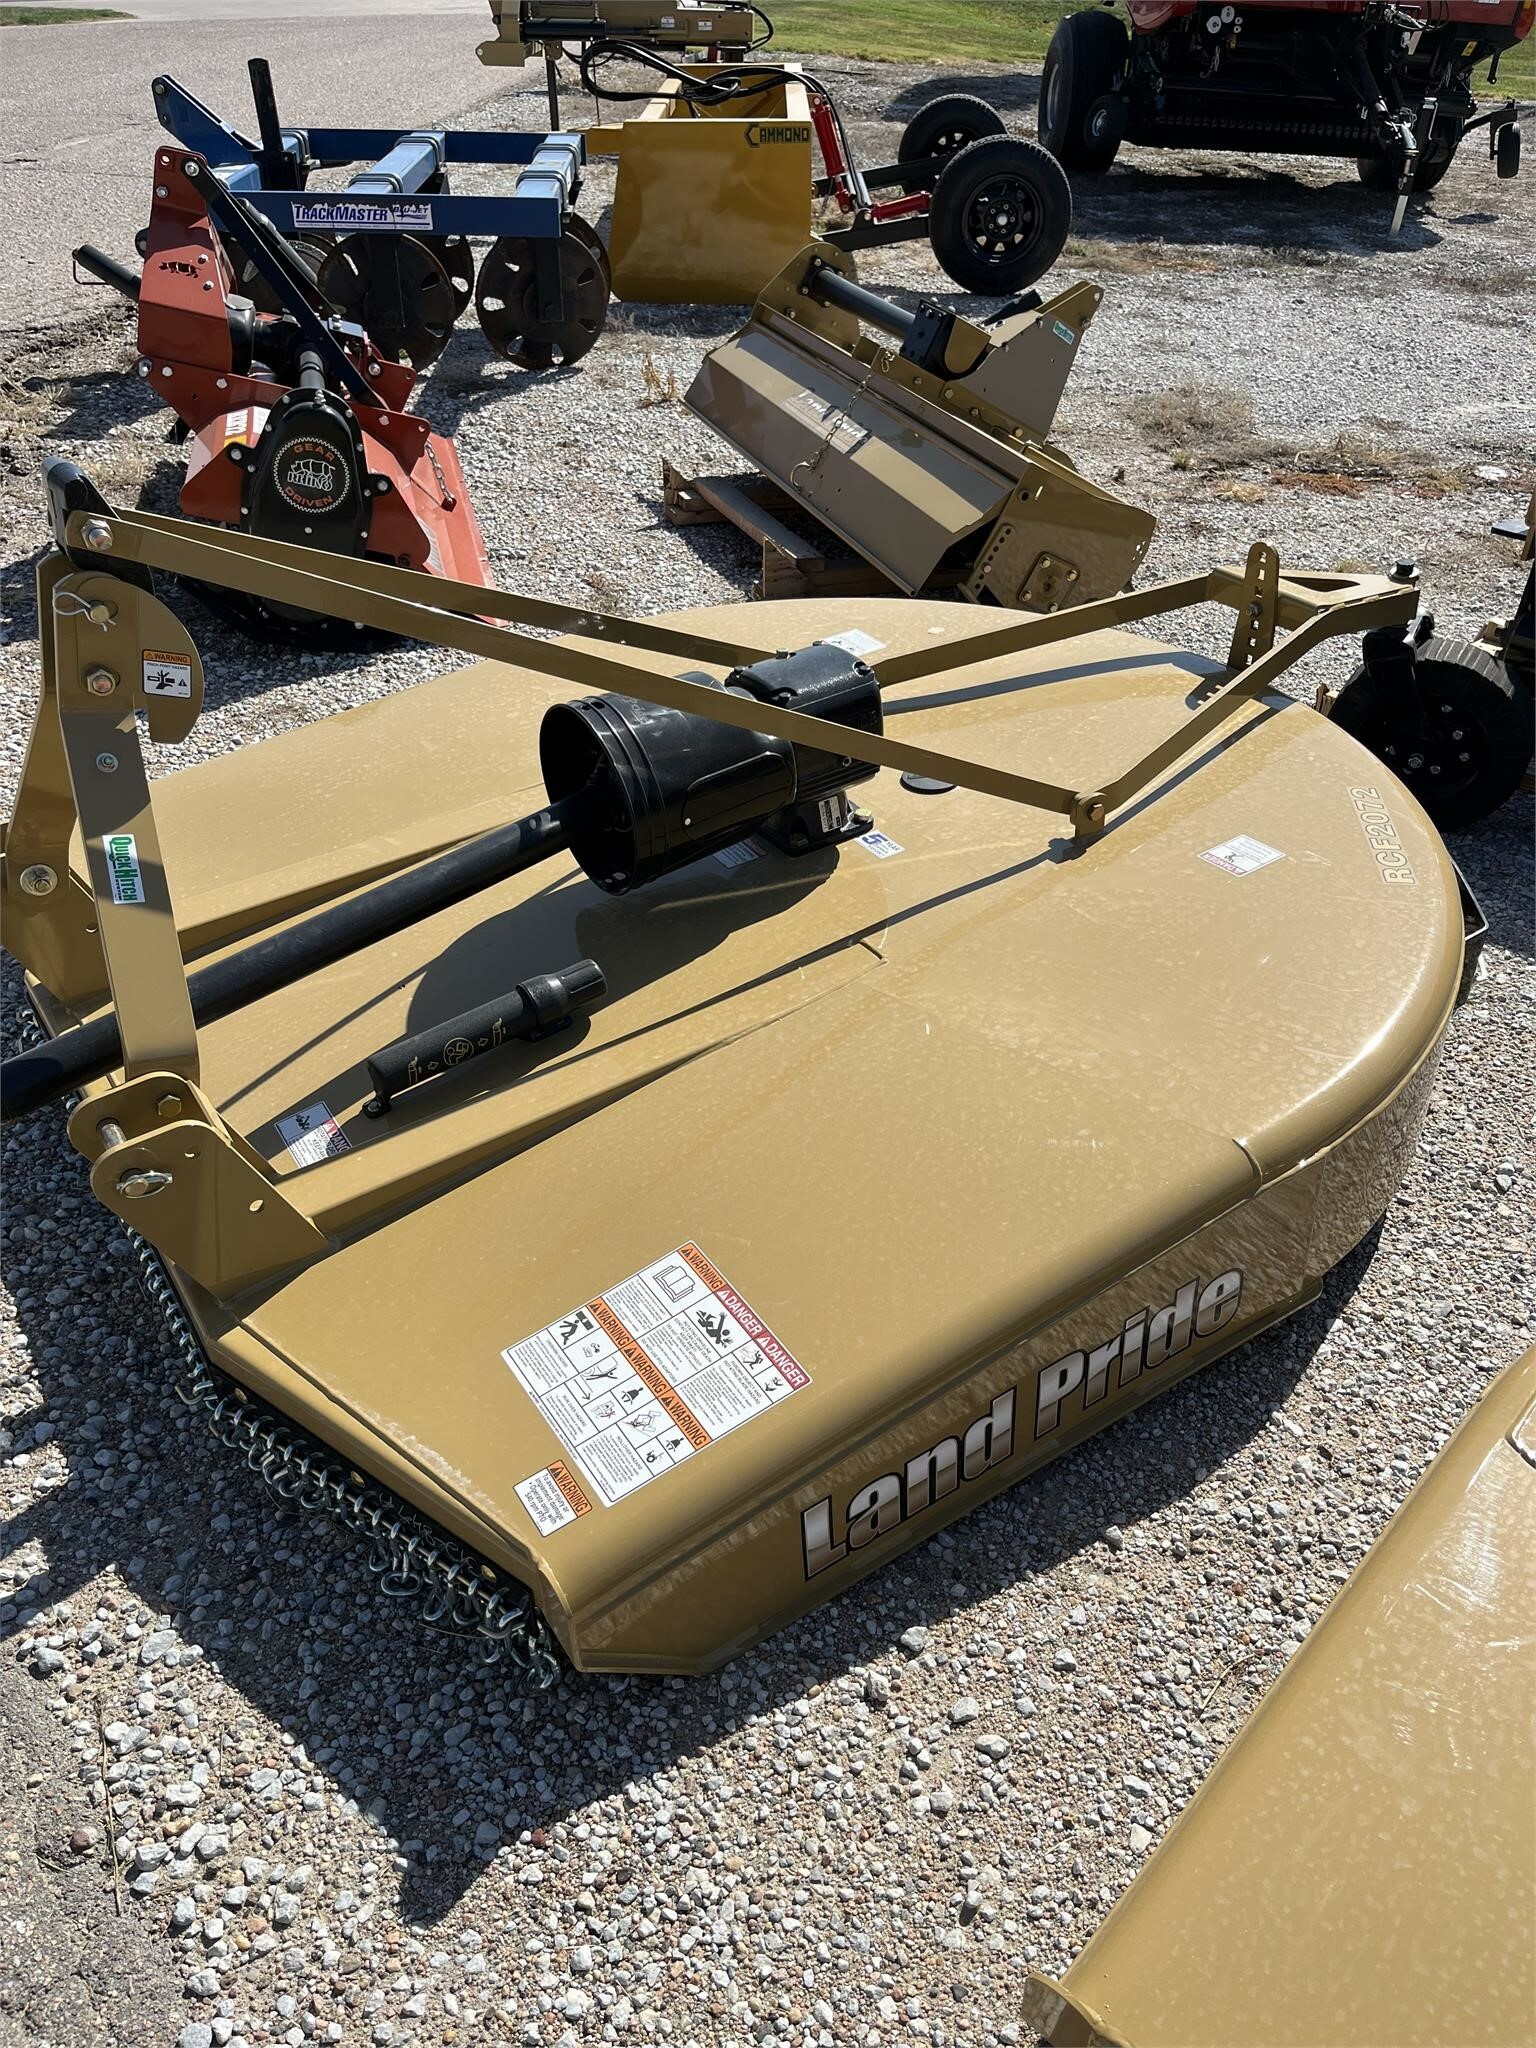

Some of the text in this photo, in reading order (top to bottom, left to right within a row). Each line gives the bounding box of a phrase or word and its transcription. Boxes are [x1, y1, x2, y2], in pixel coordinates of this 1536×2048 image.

[744, 124, 809, 147] CAMMOND
[294, 443, 335, 462] GEAR
[284, 486, 333, 507] DRIVEN
[153, 652, 188, 664] WARNING
[861, 833, 889, 846] 5
[1350, 787, 1416, 885] RCF2072
[687, 1252, 724, 1290] WARNING
[594, 1307, 630, 1347] WARNING
[723, 1294, 764, 1336] DANGER
[633, 1356, 667, 1394] WARNING
[764, 1341, 808, 1386] DANGER
[667, 1401, 708, 1446] WARNING
[799, 1267, 1245, 1582] Land Pride
[541, 1473, 550, 1481] To
[545, 1479, 557, 1493] avoid
[556, 1472, 588, 1512] WARNING
[528, 1484, 544, 1504] Operate
[535, 1509, 547, 1522] PTO
